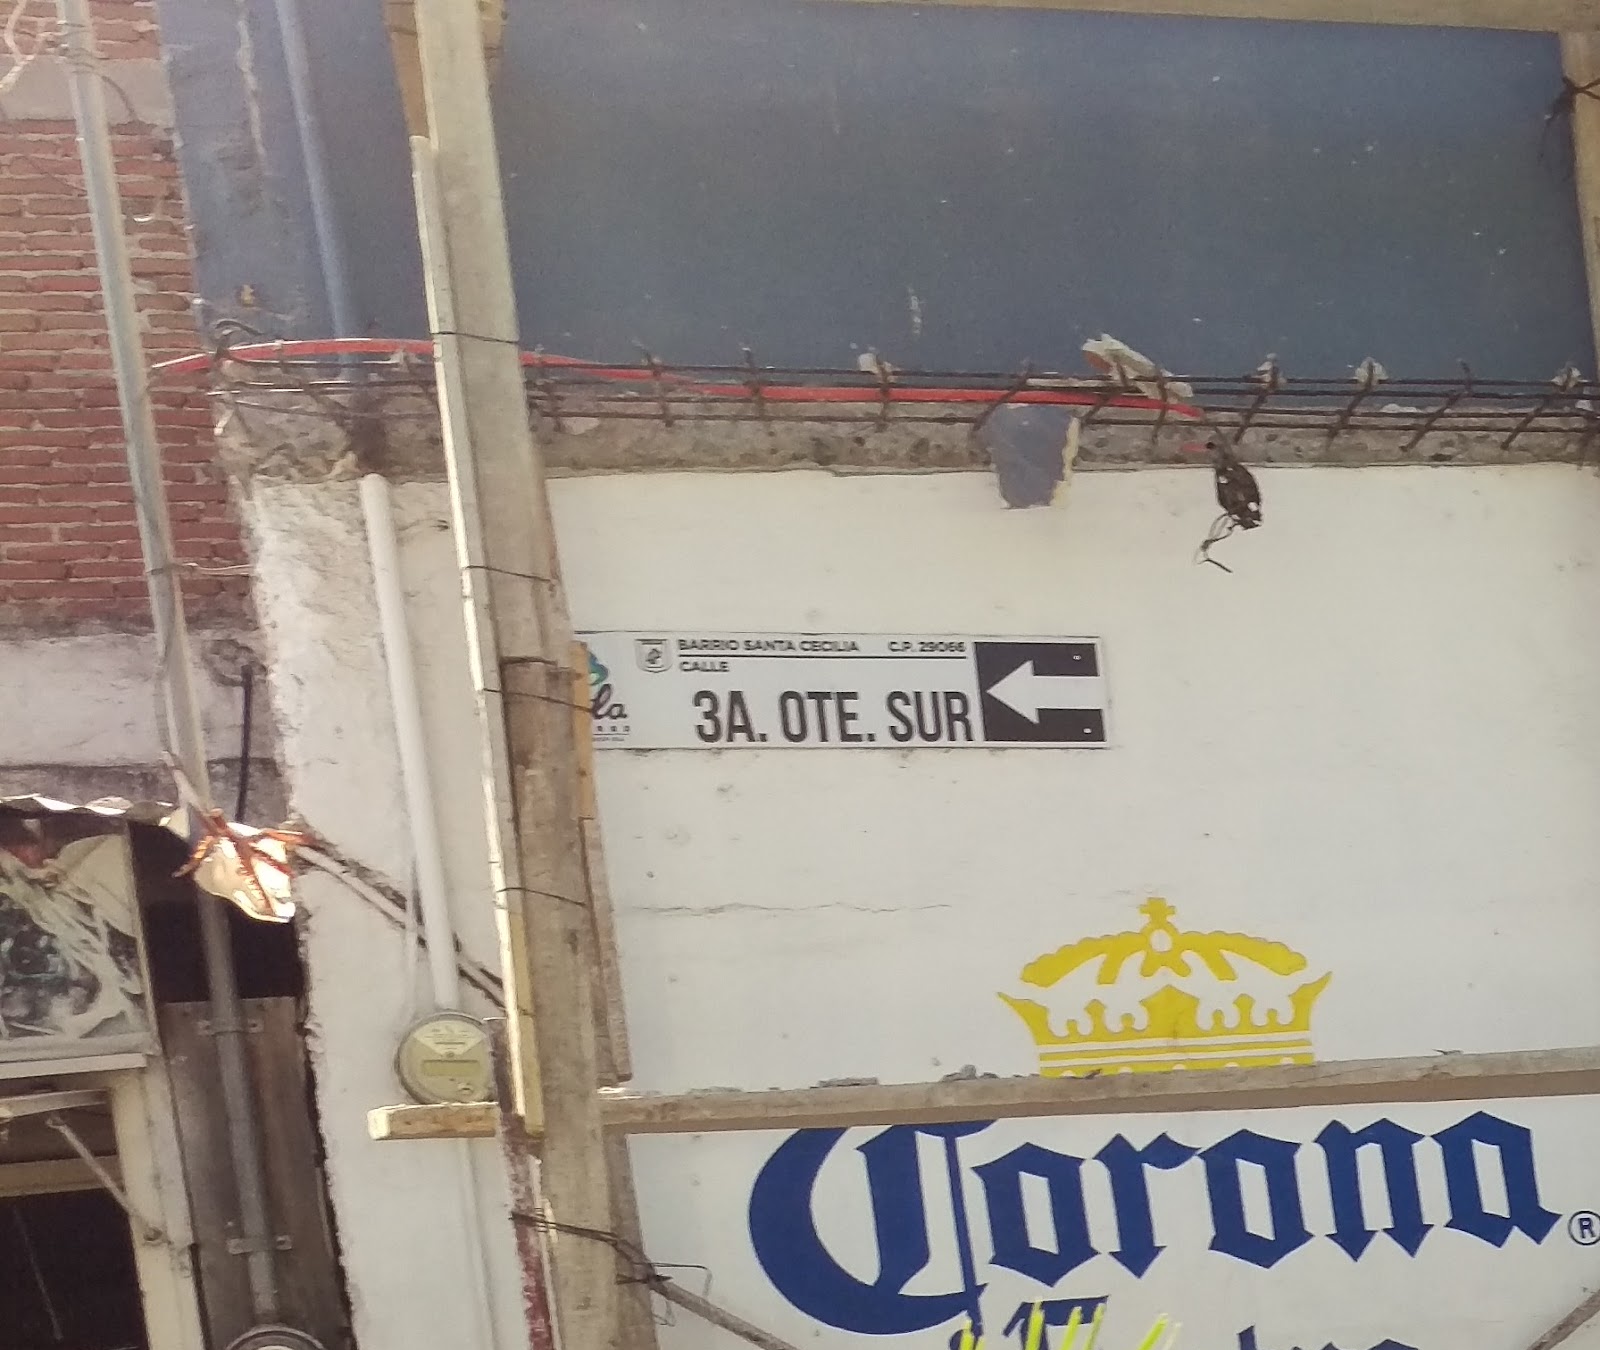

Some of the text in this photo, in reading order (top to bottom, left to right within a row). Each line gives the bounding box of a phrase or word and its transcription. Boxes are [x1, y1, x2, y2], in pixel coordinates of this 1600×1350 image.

[678, 639, 739, 651] BARRIO
[743, 640, 796, 652] SANTA
[800, 640, 860, 652] CECILIA
[888, 641, 914, 653] C.P.
[680, 661, 729, 672] CALLE
[693, 690, 975, 743] 3A. OTE. SUR
